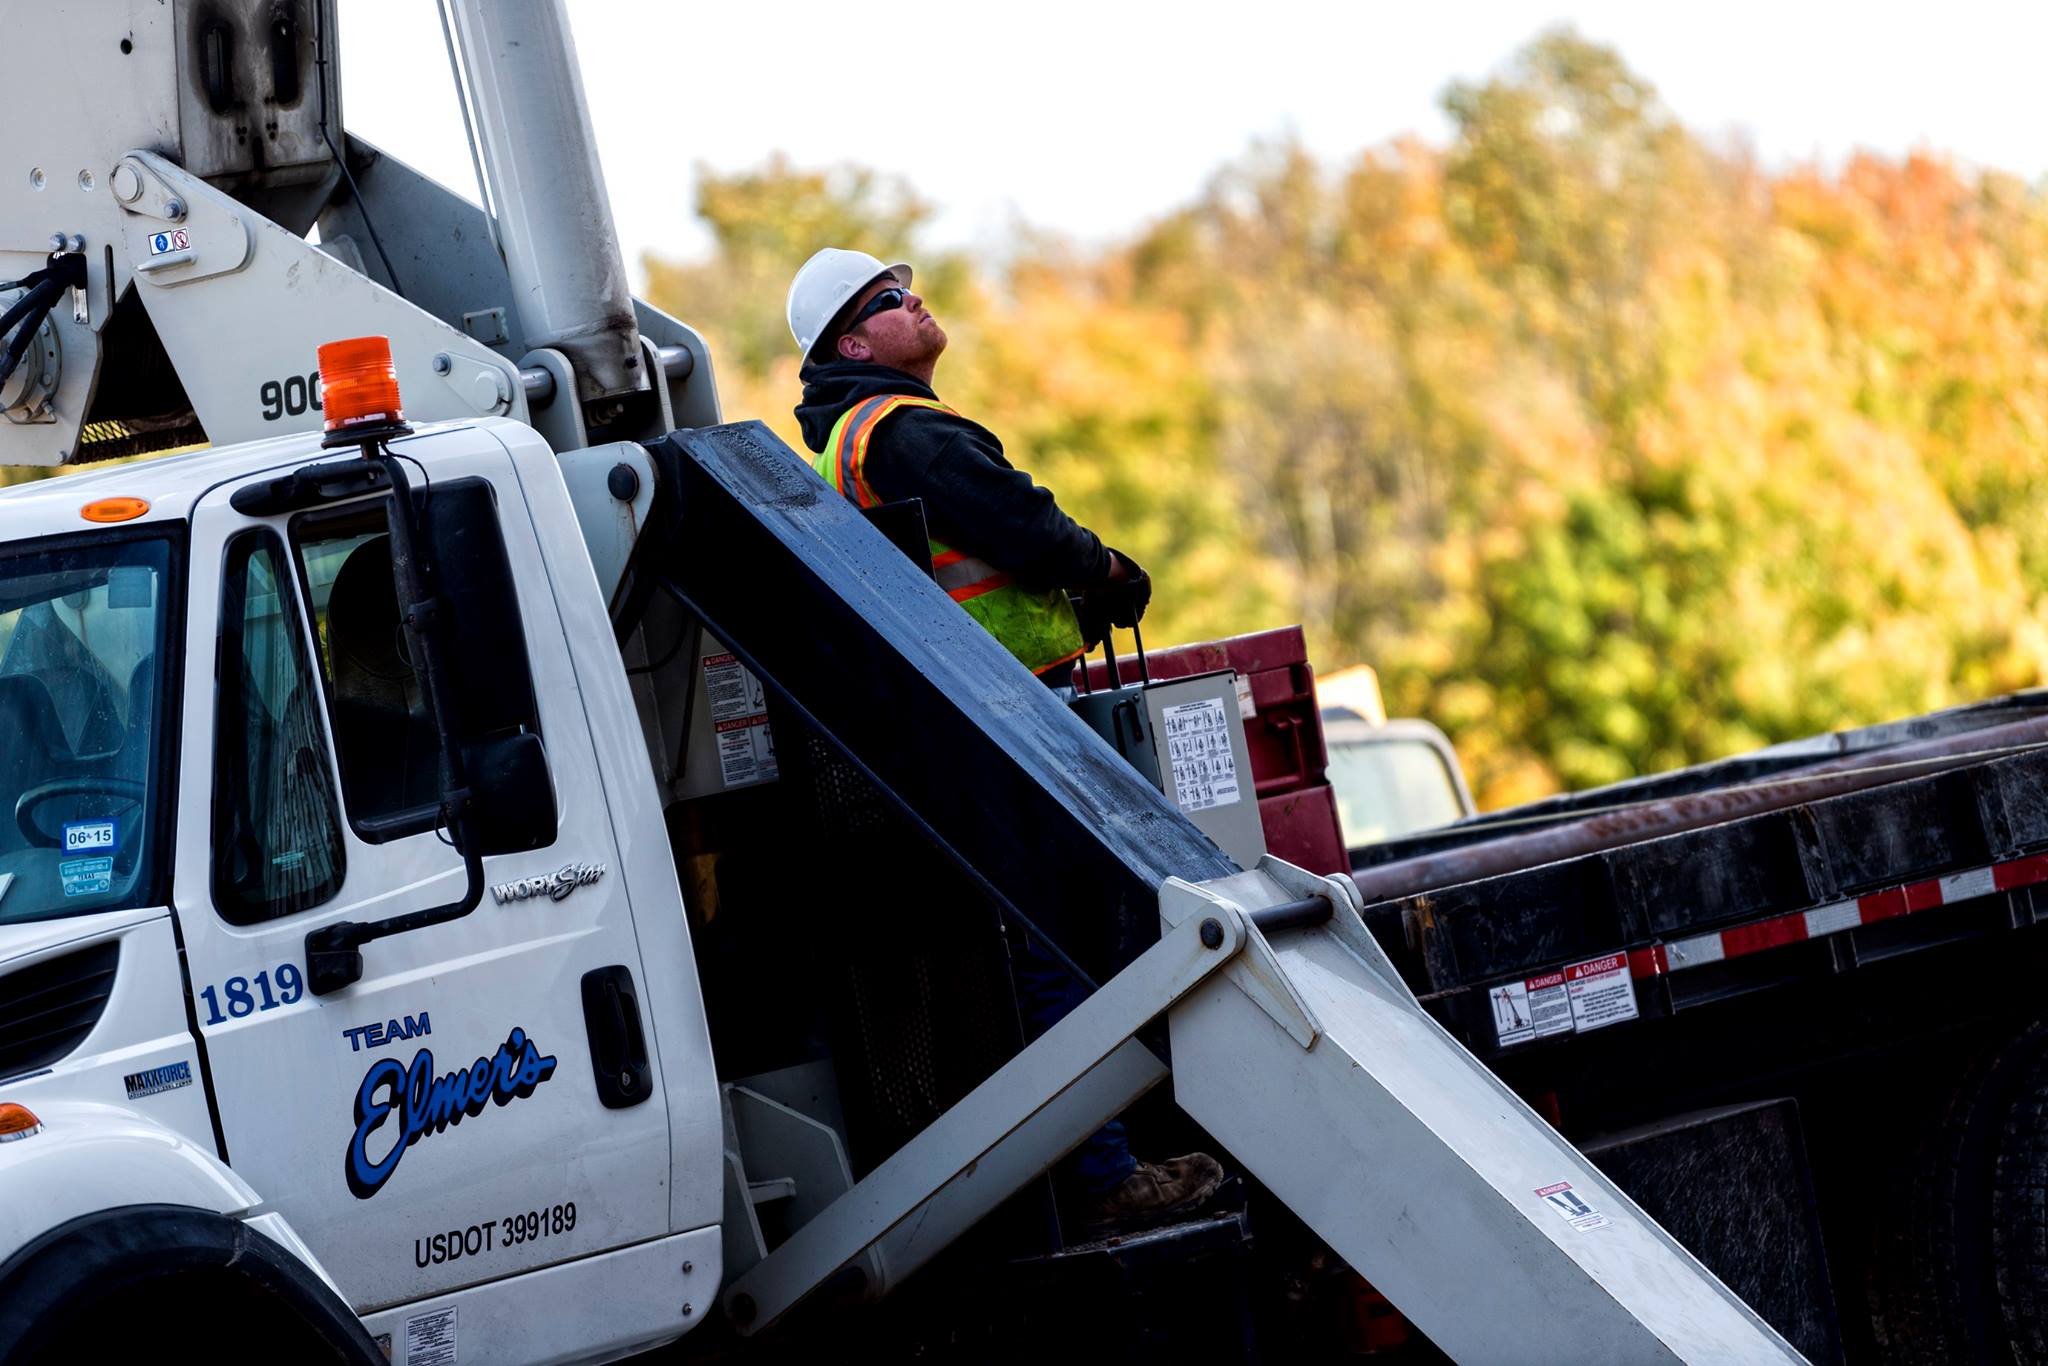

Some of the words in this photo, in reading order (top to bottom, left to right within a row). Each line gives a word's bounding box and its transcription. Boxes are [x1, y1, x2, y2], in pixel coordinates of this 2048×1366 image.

[69, 831, 86, 844] 06
[94, 829, 111, 841] 15
[1535, 974, 1562, 988] DANGER
[1583, 957, 1618, 976] DANGER
[200, 963, 303, 1026] 1819
[343, 1011, 431, 1051] TEAM
[125, 1061, 191, 1093] MAXXFORCE
[345, 1027, 558, 1200] Elmer's
[415, 1220, 497, 1268] USDOT
[502, 1201, 577, 1248] 399189
